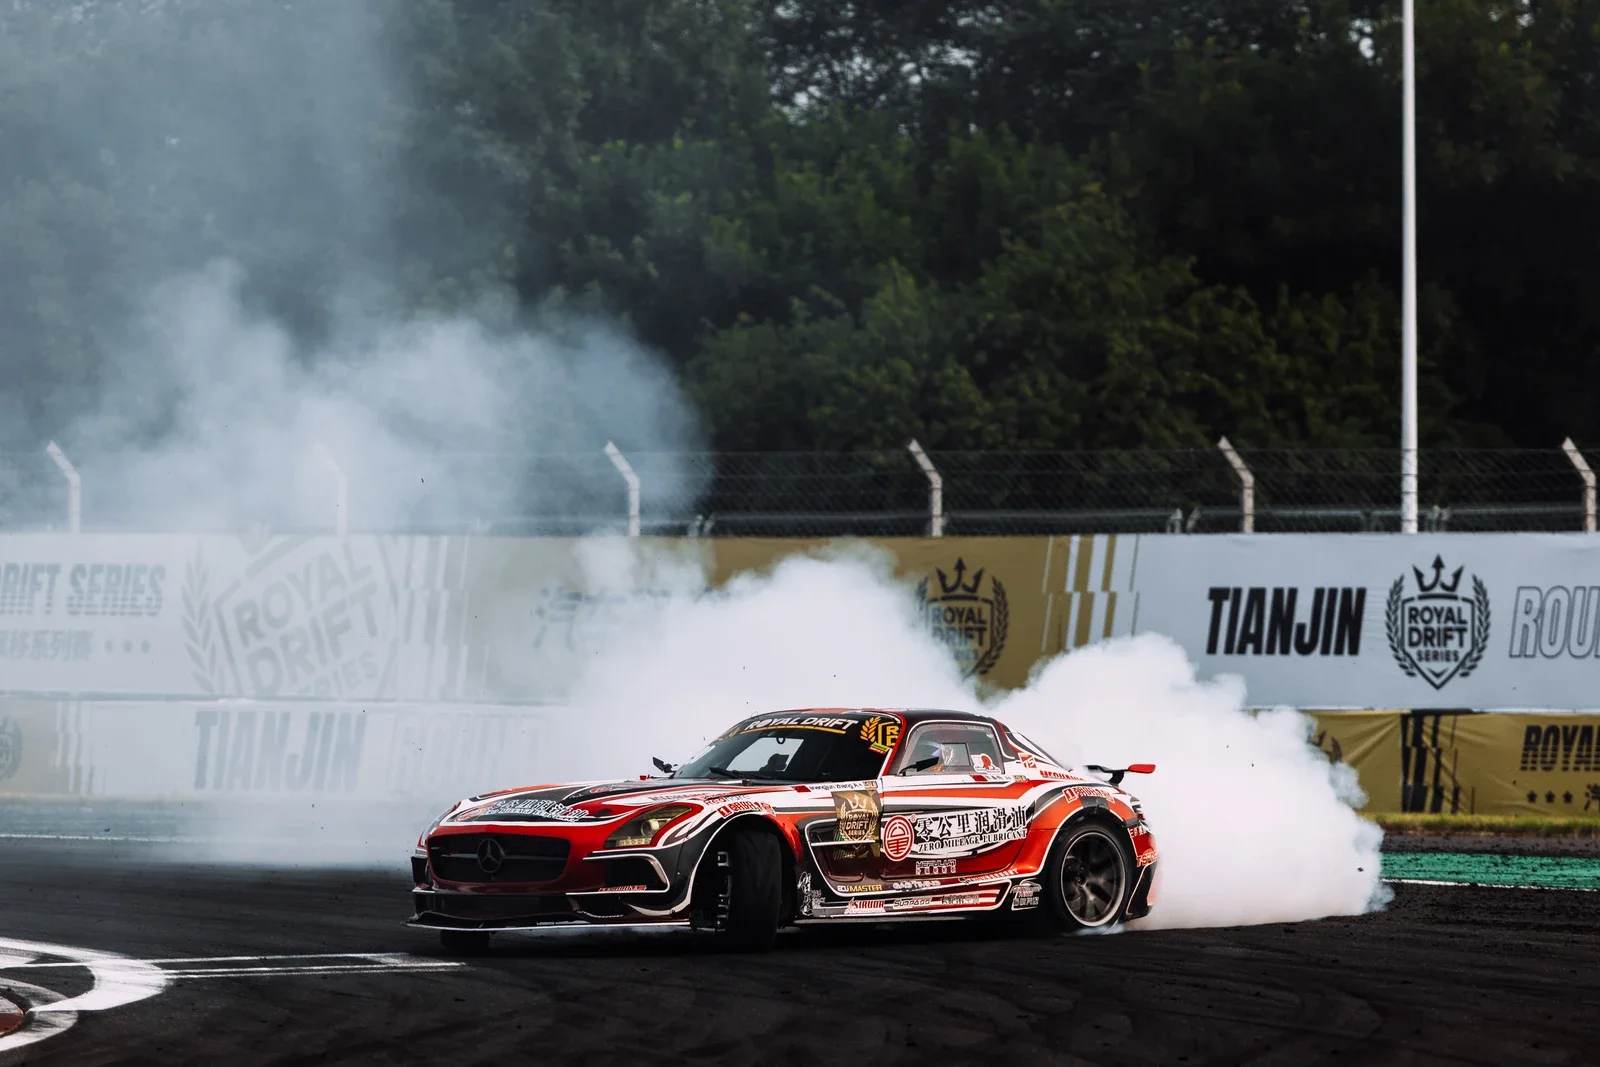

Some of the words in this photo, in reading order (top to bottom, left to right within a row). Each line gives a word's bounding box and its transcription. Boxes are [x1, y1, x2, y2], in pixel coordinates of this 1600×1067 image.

[0, 562, 61, 616] RIFT
[67, 562, 166, 616] SERIES
[233, 541, 373, 648] ROYAL
[931, 606, 988, 625] ROYAL
[1206, 587, 1367, 657] TIANJIN
[1408, 606, 1468, 626] ROYAL
[1508, 585, 1600, 659] ROU
[246, 580, 379, 695] DRIFT
[1407, 626, 1468, 647] DRIFT
[1417, 649, 1460, 663] SERIES
[744, 717, 802, 731] ROYAL
[801, 717, 859, 731] DRIFT
[194, 710, 368, 791] TIANJIN
[845, 820, 869, 830] DRIFT
[848, 813, 870, 821] ROYAL
[915, 805, 1026, 841] 零公里润滑油
[918, 840, 941, 853] ZERO
[943, 837, 980, 850] MILEAGE
[983, 828, 1028, 843] LUBRICANT
